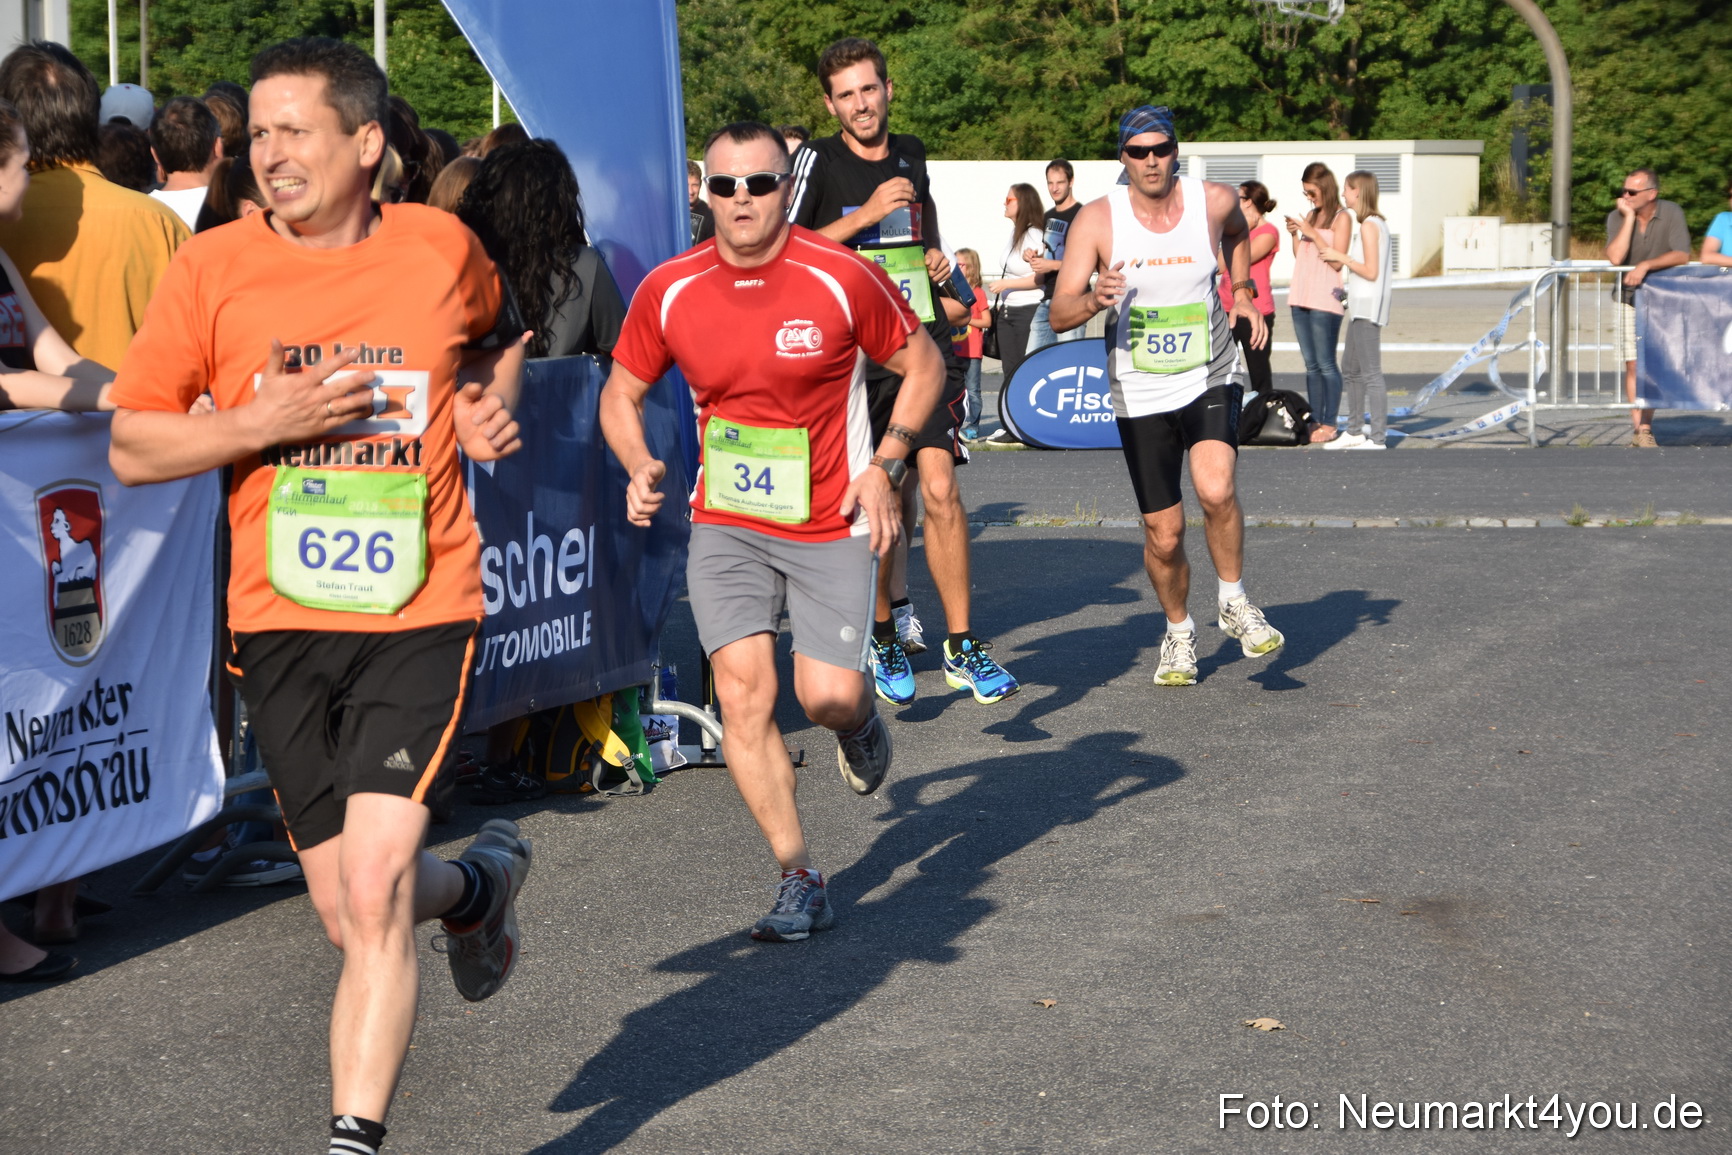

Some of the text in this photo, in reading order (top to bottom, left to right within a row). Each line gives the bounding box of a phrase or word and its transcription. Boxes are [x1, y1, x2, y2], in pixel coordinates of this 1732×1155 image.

[1147, 256, 1197, 266] KLEBL
[734, 279, 759, 288] CRAFT
[1147, 332, 1193, 354] 587
[734, 463, 775, 495] 34
[291, 492, 347, 505] firmenlauf
[298, 527, 395, 573] 626
[316, 580, 373, 592] Stefan Traut
[63, 620, 92, 648] 1628
